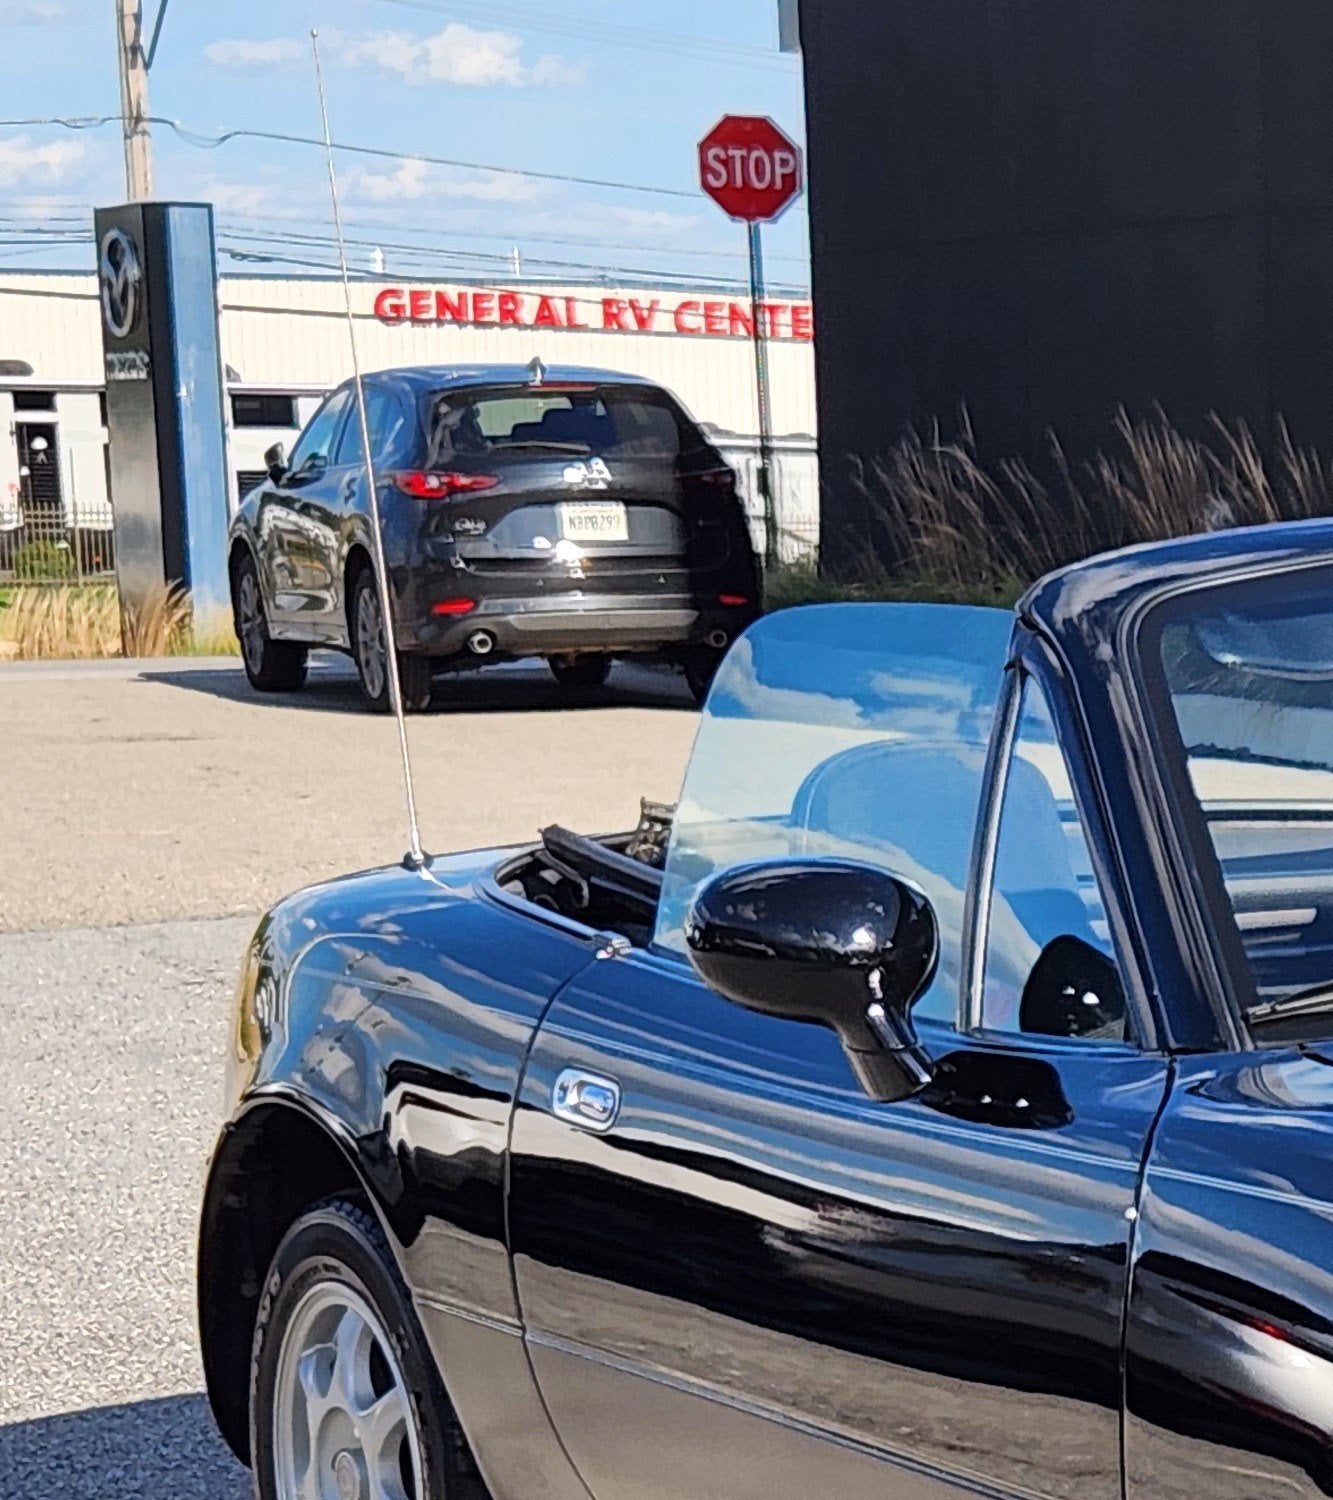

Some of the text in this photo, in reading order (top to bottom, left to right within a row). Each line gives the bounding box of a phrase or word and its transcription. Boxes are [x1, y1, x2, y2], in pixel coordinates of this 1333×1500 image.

[706, 147, 795, 191] STOP
[373, 288, 813, 340] GENERAL RV CENTE
